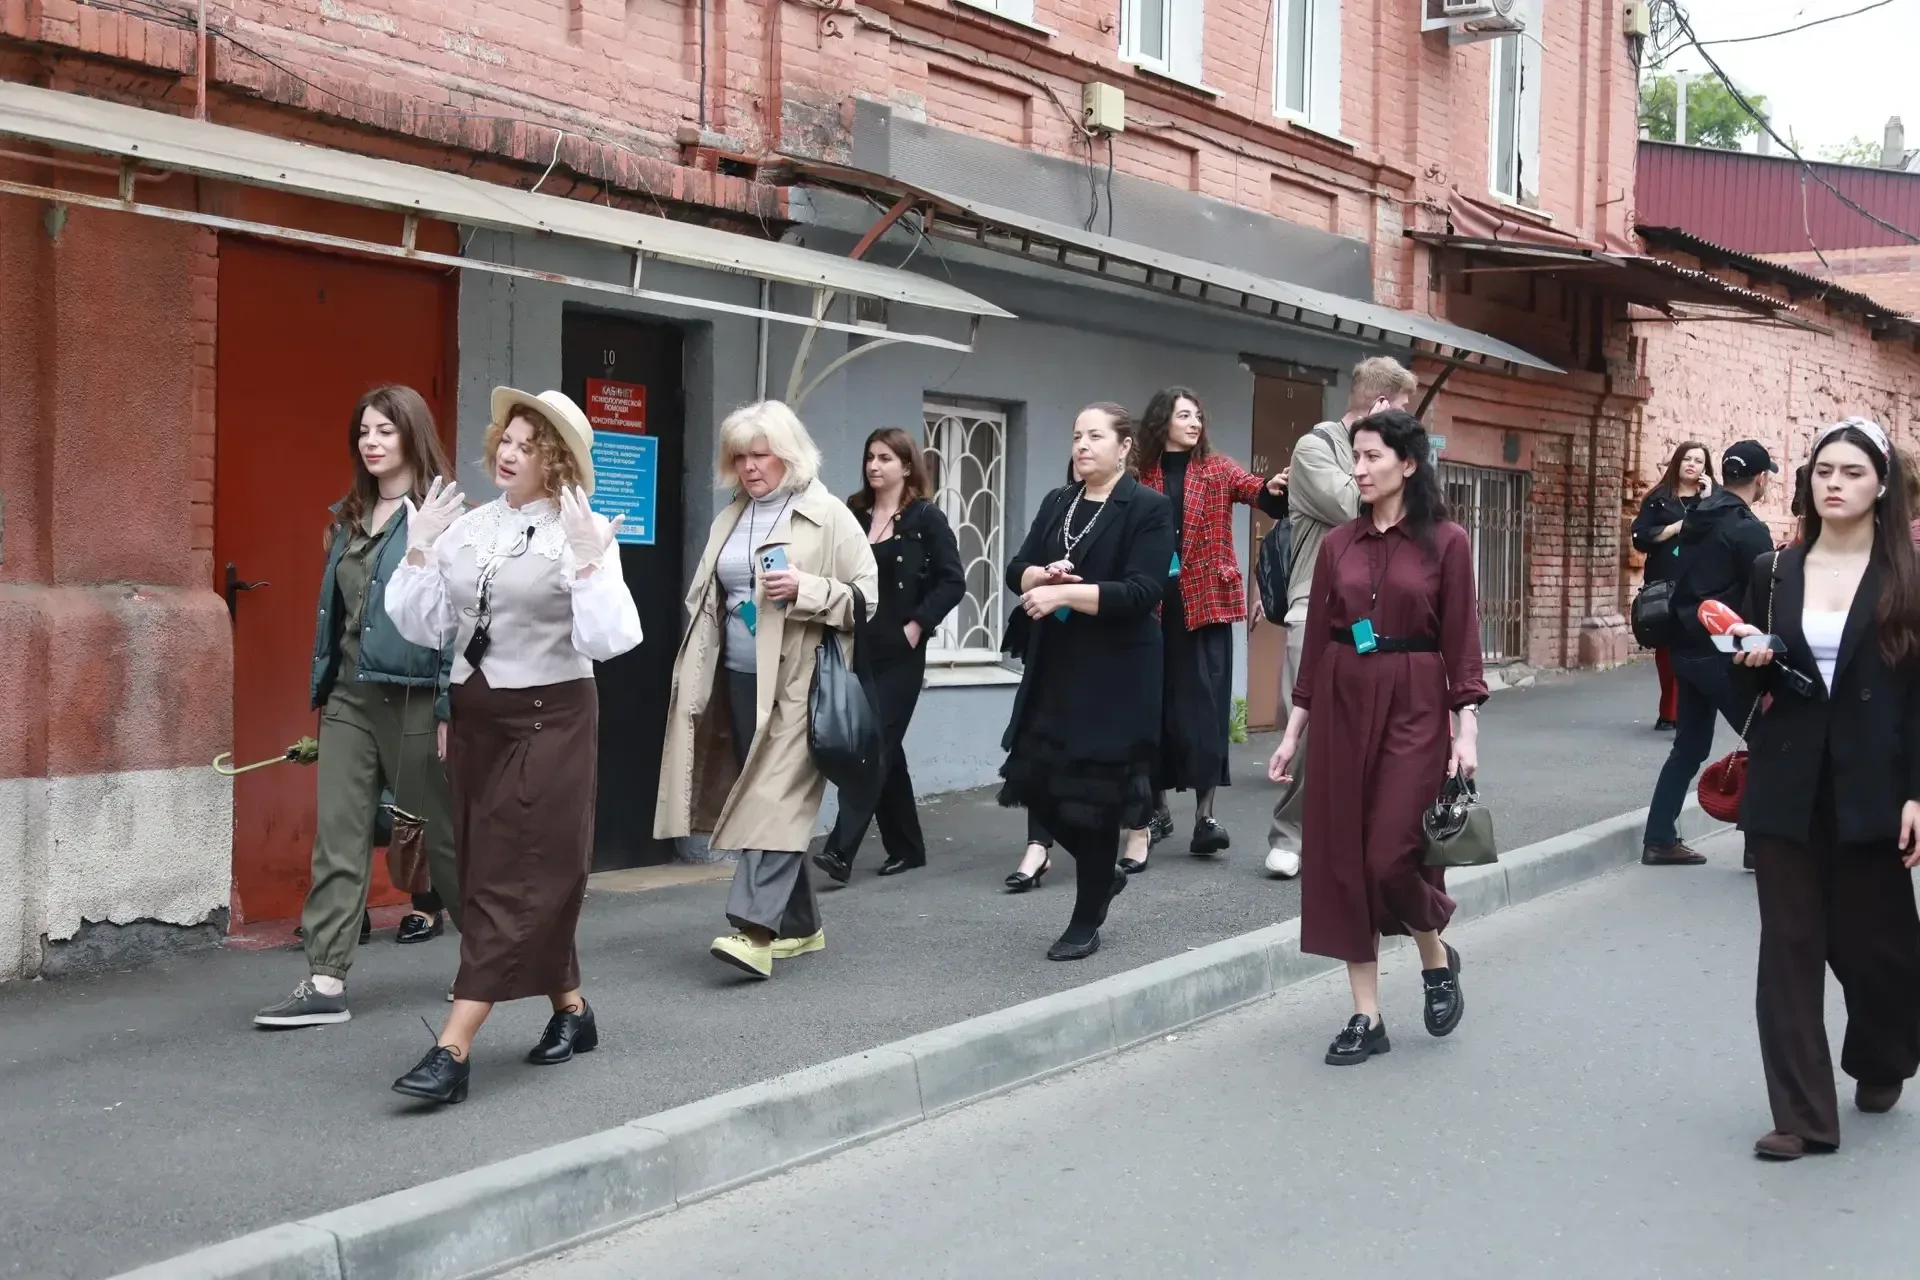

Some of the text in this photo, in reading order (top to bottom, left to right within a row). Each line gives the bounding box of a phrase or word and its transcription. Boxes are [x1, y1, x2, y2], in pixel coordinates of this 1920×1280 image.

[603, 350, 616, 365] 10
[591, 395, 642, 408] ПСИХОЛОГИЧЕСКОЙ
[604, 403, 629, 413] ПОМОЩИ
